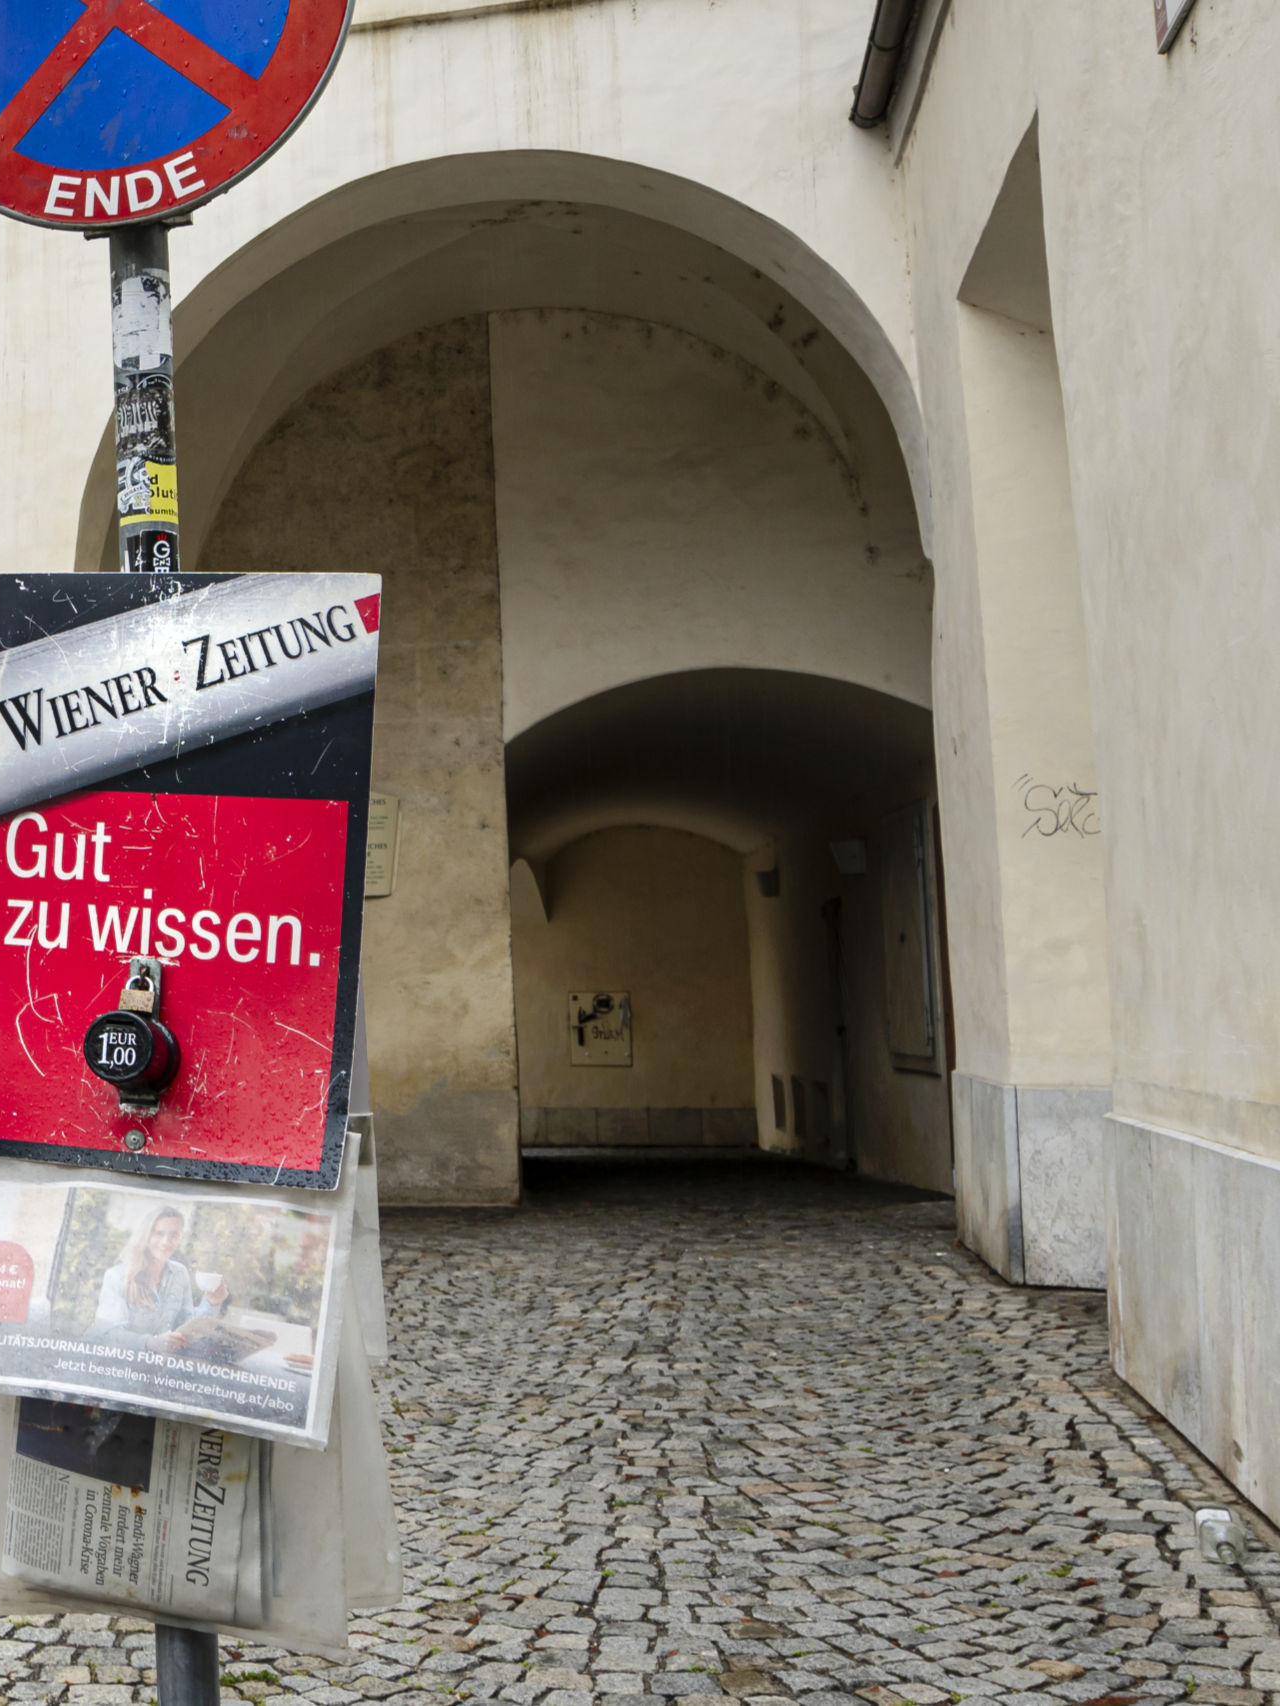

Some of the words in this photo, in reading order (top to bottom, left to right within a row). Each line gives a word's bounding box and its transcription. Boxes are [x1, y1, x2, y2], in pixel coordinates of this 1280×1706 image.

[44, 151, 206, 218] ENDE
[182, 604, 358, 692] ZEITUNG
[5, 812, 112, 882] Gut
[3, 898, 70, 950] zu
[88, 888, 322, 967] wissen.
[109, 1032, 137, 1046] EUR
[8, 1264, 19, 1276] €
[54, 1358, 86, 1373] Jetzt
[88, 1361, 150, 1383] bestellen:
[153, 1374, 295, 1412] wienerzeitung.at/abo
[137, 1350, 164, 1367] FÜR
[166, 1357, 194, 1372] DAS
[196, 1362, 297, 1393] WOCHENENDE
[86, 1488, 96, 1500] in
[99, 1486, 114, 1531] zentrale
[79, 1502, 98, 1575] Corona-Krise
[116, 1504, 130, 1544] fordert
[127, 1508, 148, 1586] Rendi-Wagner
[185, 1482, 226, 1588] ZEITUNG
[95, 1532, 113, 1586] Vorgaben
[112, 1545, 126, 1578] mehr
